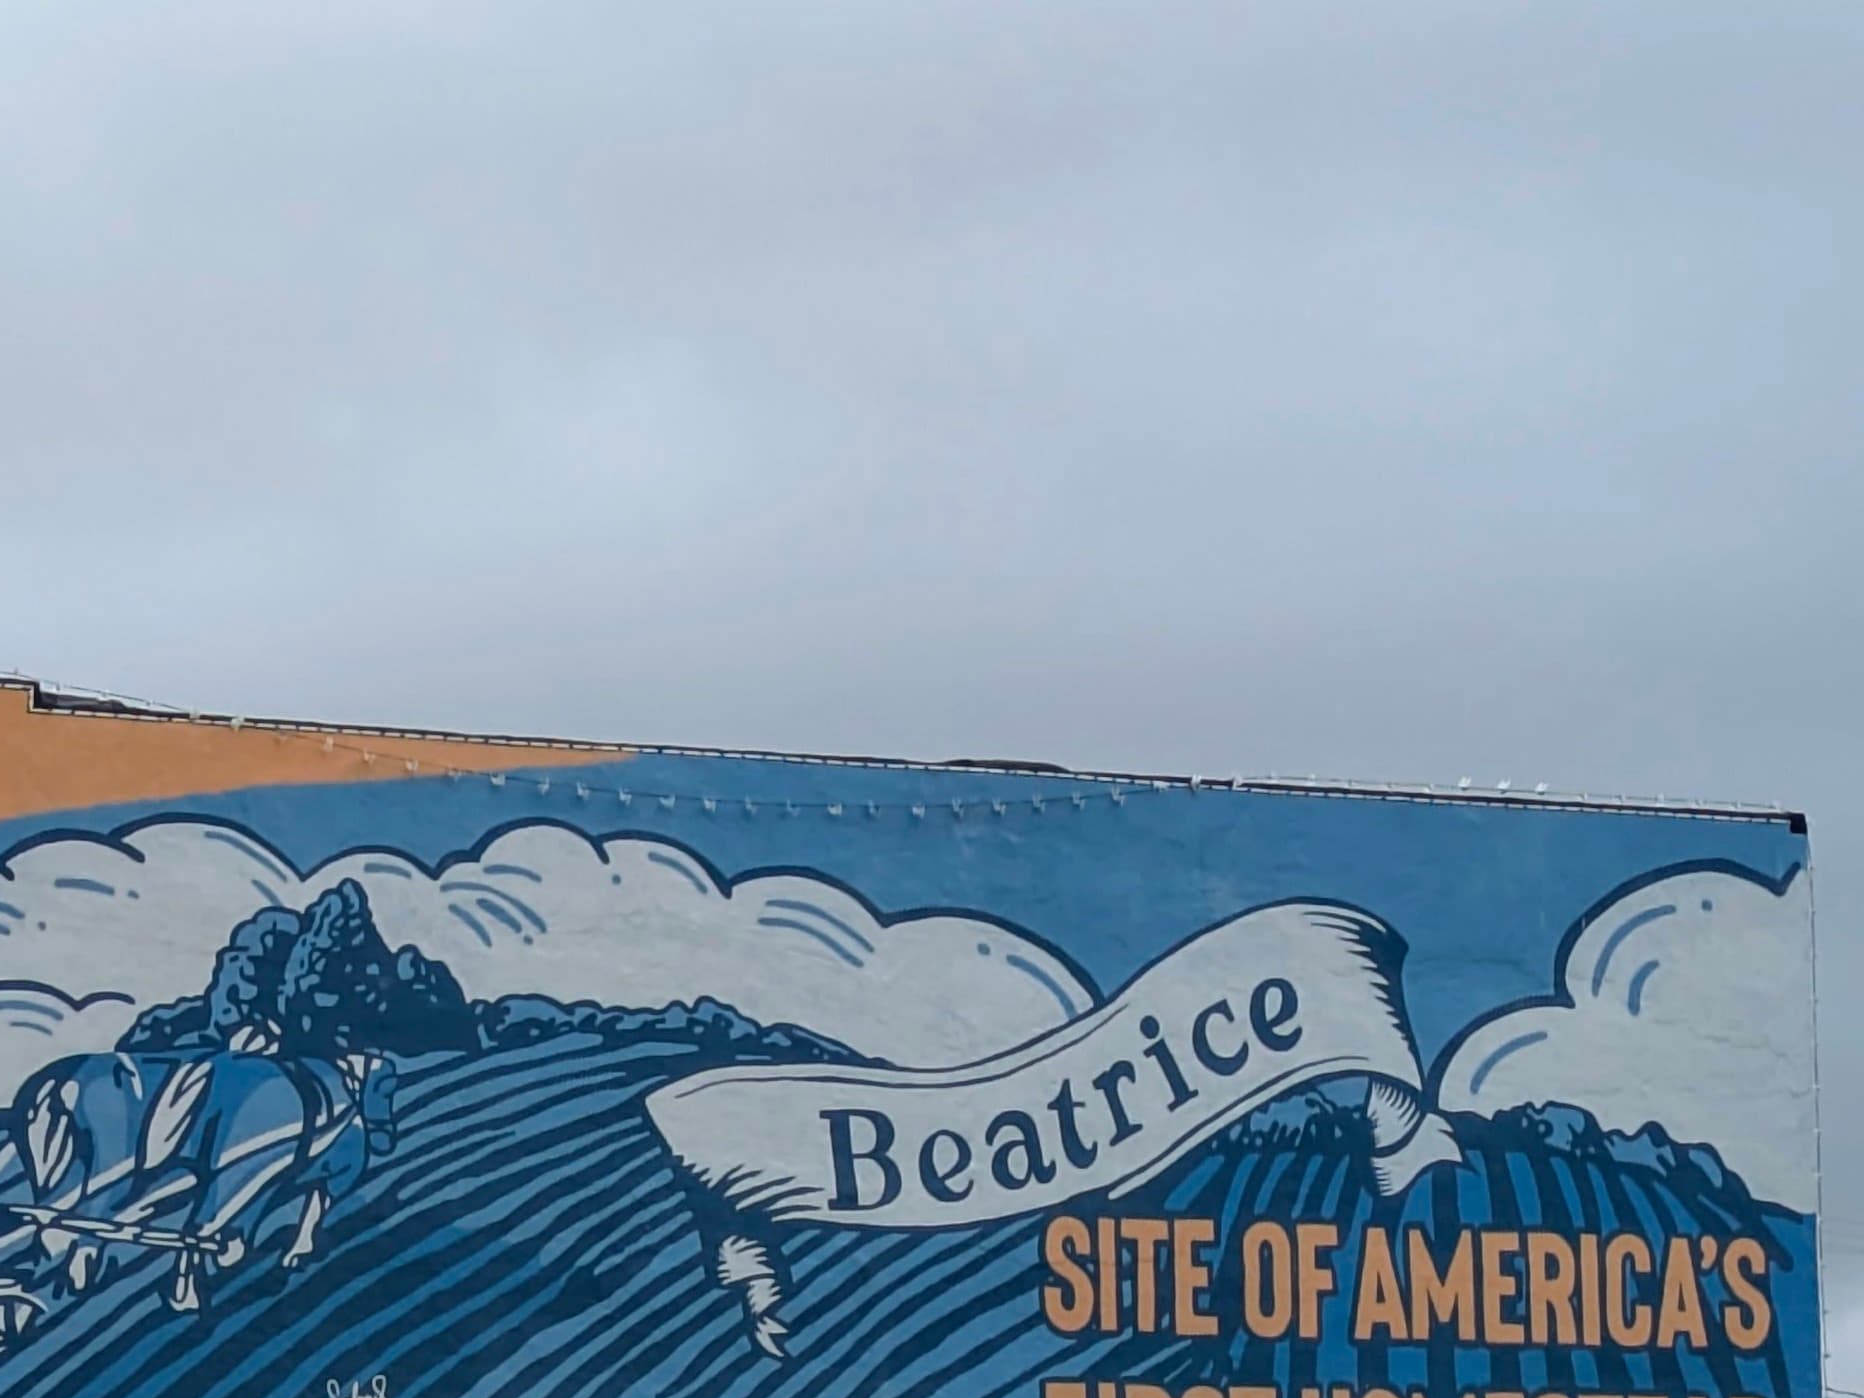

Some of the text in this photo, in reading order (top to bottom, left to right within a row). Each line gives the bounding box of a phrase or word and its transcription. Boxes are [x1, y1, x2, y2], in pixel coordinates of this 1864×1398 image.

[819, 977, 1303, 1211] Beatrice
[1044, 1217, 1771, 1349] SITE OF AMERICA'S
